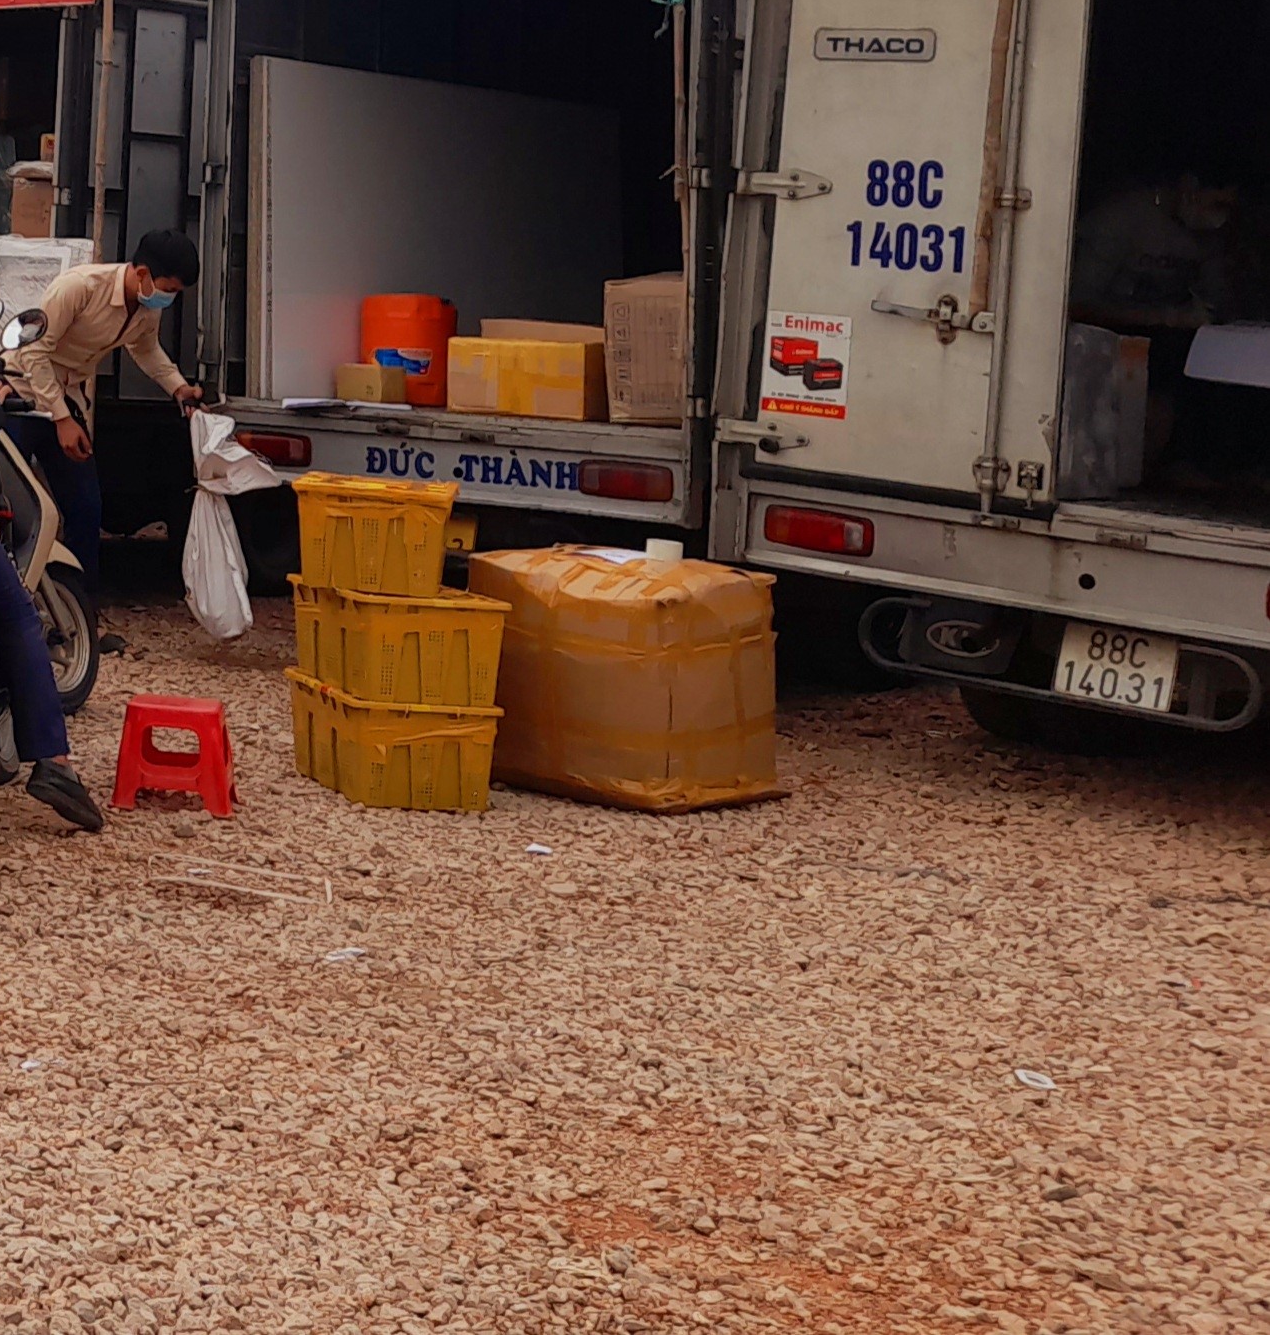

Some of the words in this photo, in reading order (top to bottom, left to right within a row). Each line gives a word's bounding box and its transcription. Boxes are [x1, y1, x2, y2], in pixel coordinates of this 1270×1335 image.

[826, 37, 924, 55] THACO
[866, 160, 945, 209] 88C
[847, 220, 966, 274] 14031
[365, 441, 436, 479] ĐỨC
[460, 451, 580, 491] THÀNH
[1088, 629, 1150, 668] 88C
[1063, 661, 1166, 709] 140.31
